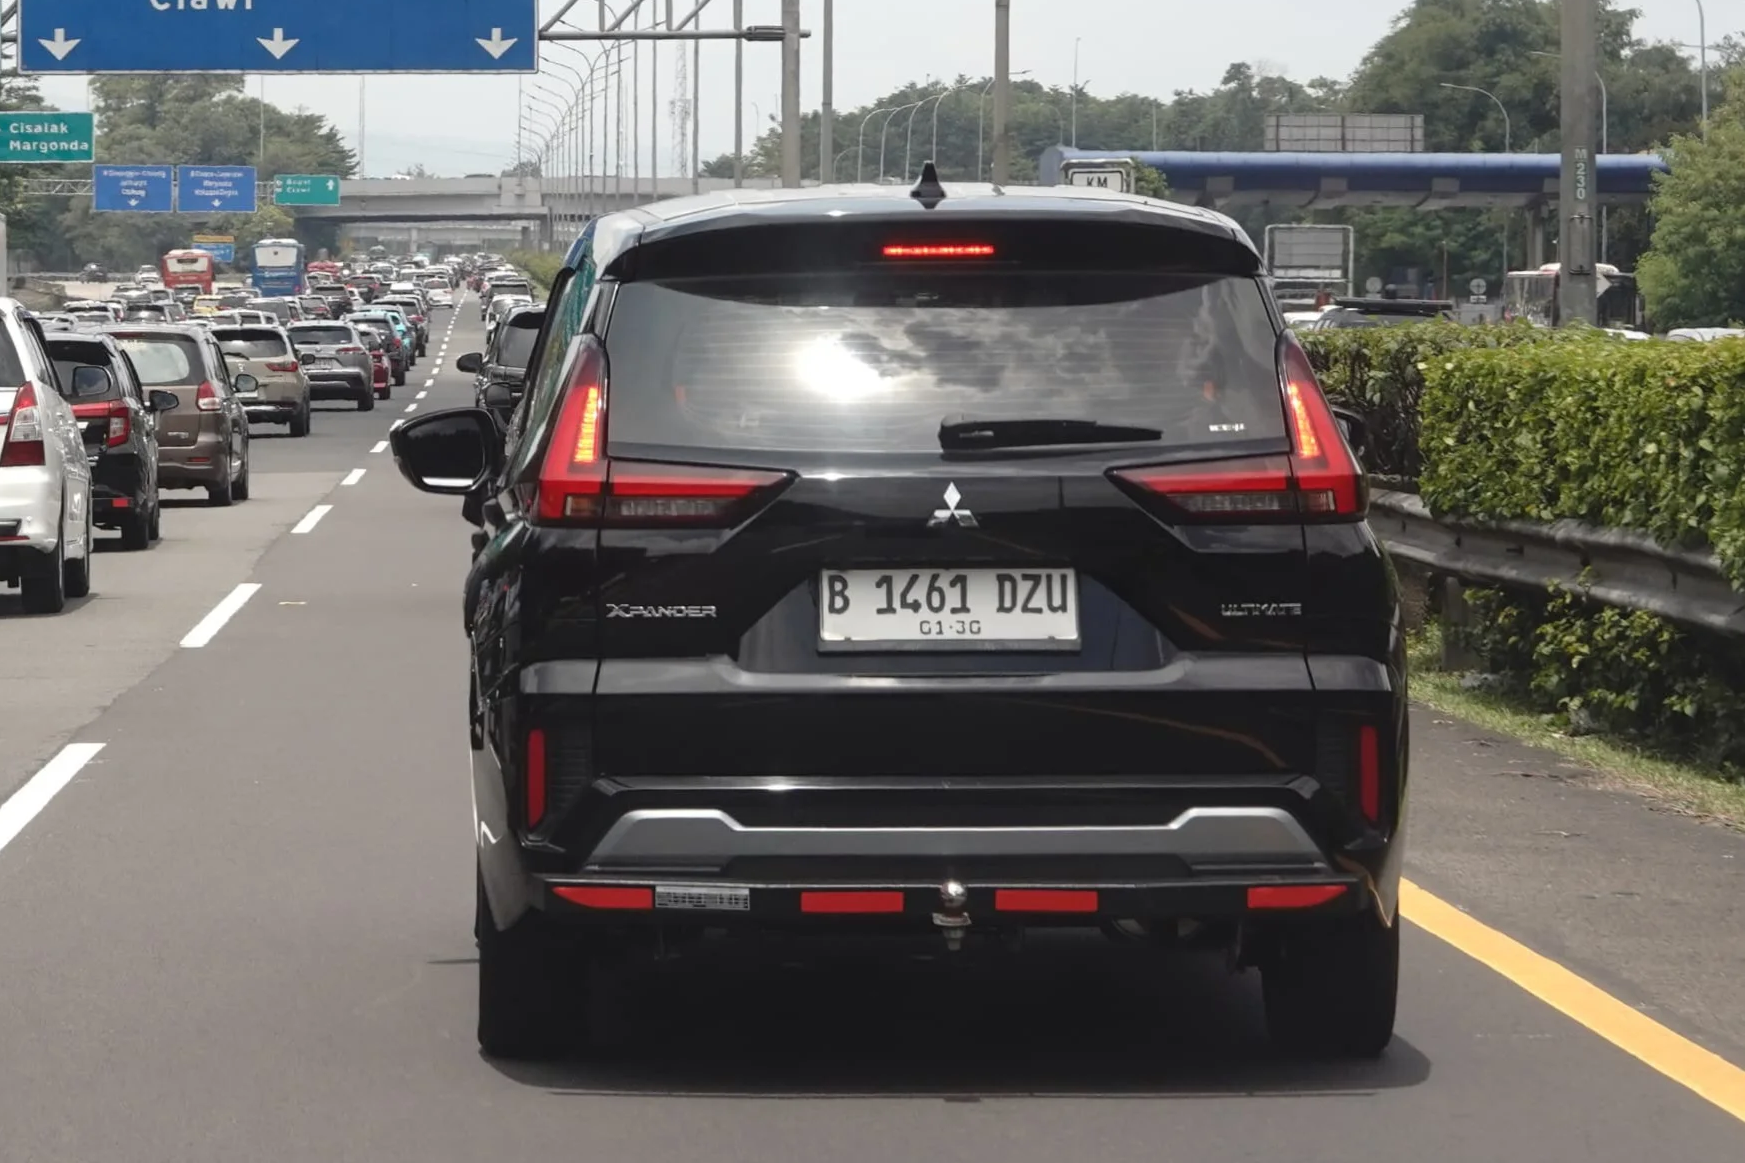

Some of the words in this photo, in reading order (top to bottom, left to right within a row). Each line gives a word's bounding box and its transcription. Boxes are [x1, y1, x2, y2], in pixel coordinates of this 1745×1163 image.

[9, 121, 69, 134] Cisalak
[9, 139, 90, 154] Margonda
[1086, 176, 1108, 188] KM
[827, 574, 850, 615] B
[874, 573, 971, 615] 1461
[995, 573, 1068, 615] DZU
[605, 603, 717, 618] XPANDER
